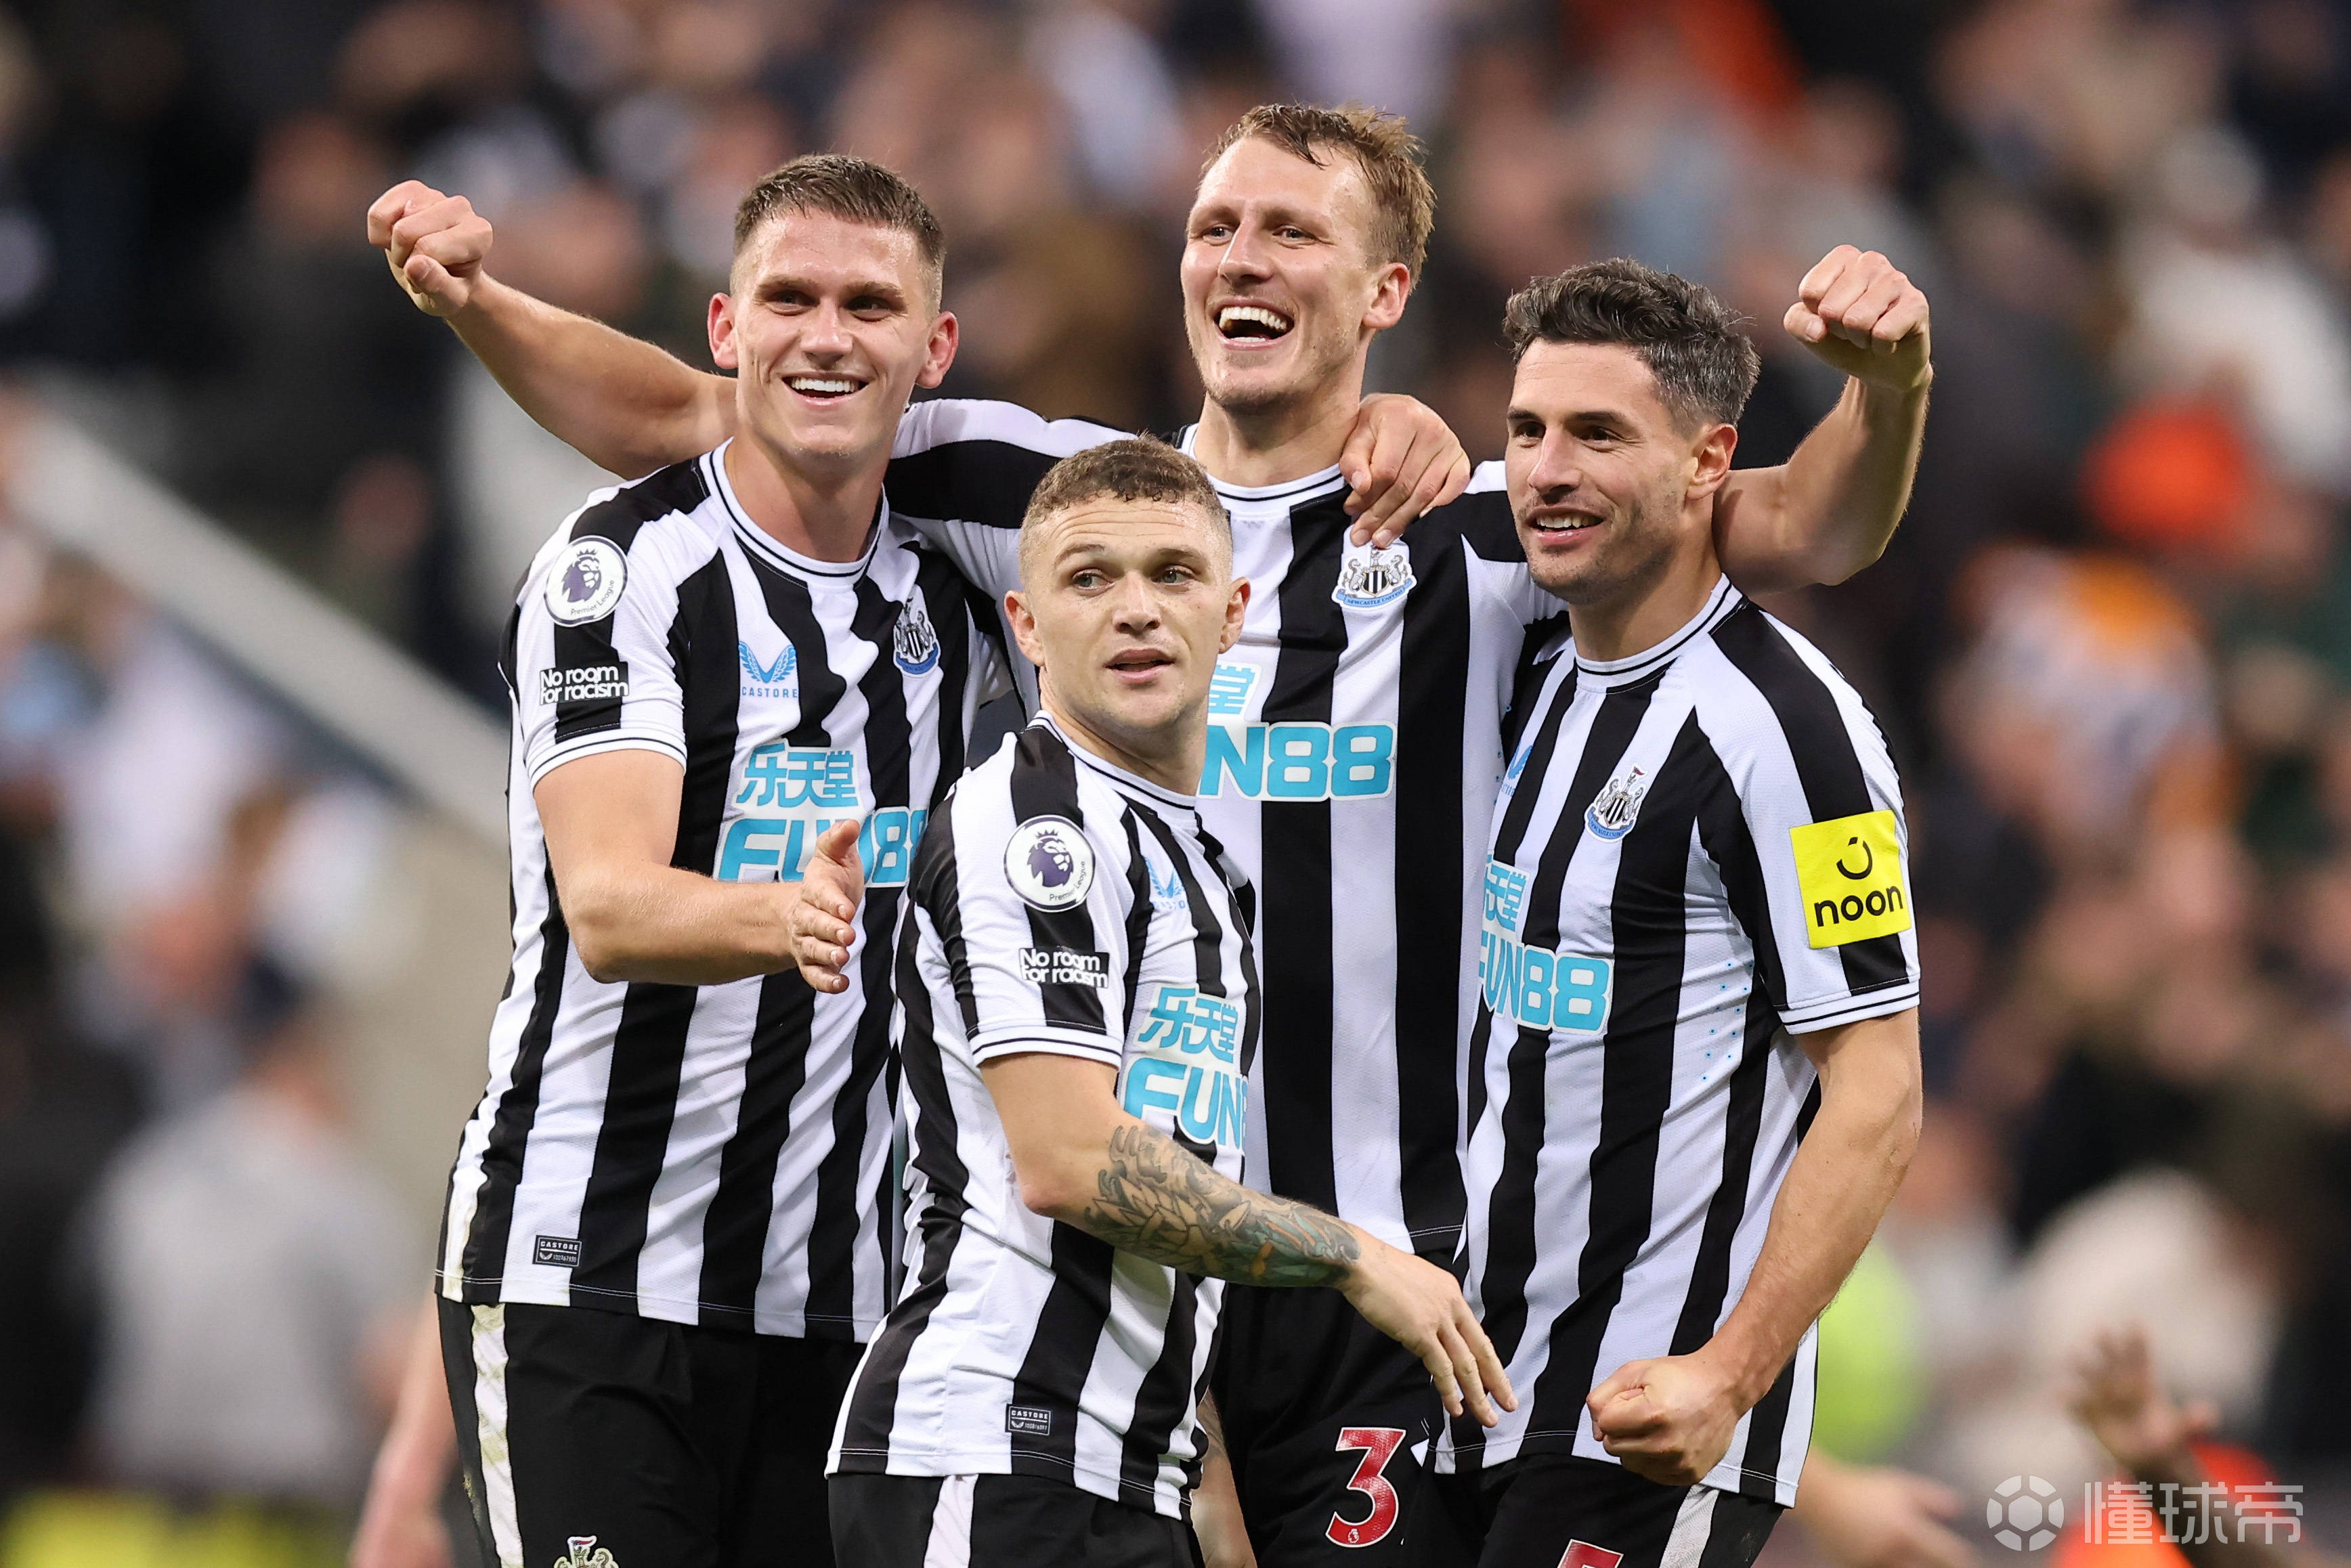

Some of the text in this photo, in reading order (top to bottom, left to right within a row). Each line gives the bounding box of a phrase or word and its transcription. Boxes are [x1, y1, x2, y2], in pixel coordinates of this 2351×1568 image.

[570, 580, 615, 616] Premier League
[540, 666, 619, 688] No room
[540, 682, 629, 705] for racism
[741, 687, 798, 698] CASTORE
[735, 742, 859, 808] 乐天堂
[1199, 724, 1394, 798] N88
[1049, 861, 1087, 901] Prem League
[1484, 854, 1527, 932] 天堂
[1814, 886, 1903, 928] noon
[1019, 948, 1101, 972] No room
[1021, 965, 1050, 983] for
[1138, 986, 1238, 1064] 乐天堂
[540, 1241, 579, 1250] CASTORE
[1011, 1410, 1048, 1420] CASTORE
[1326, 1427, 1406, 1547] 3
